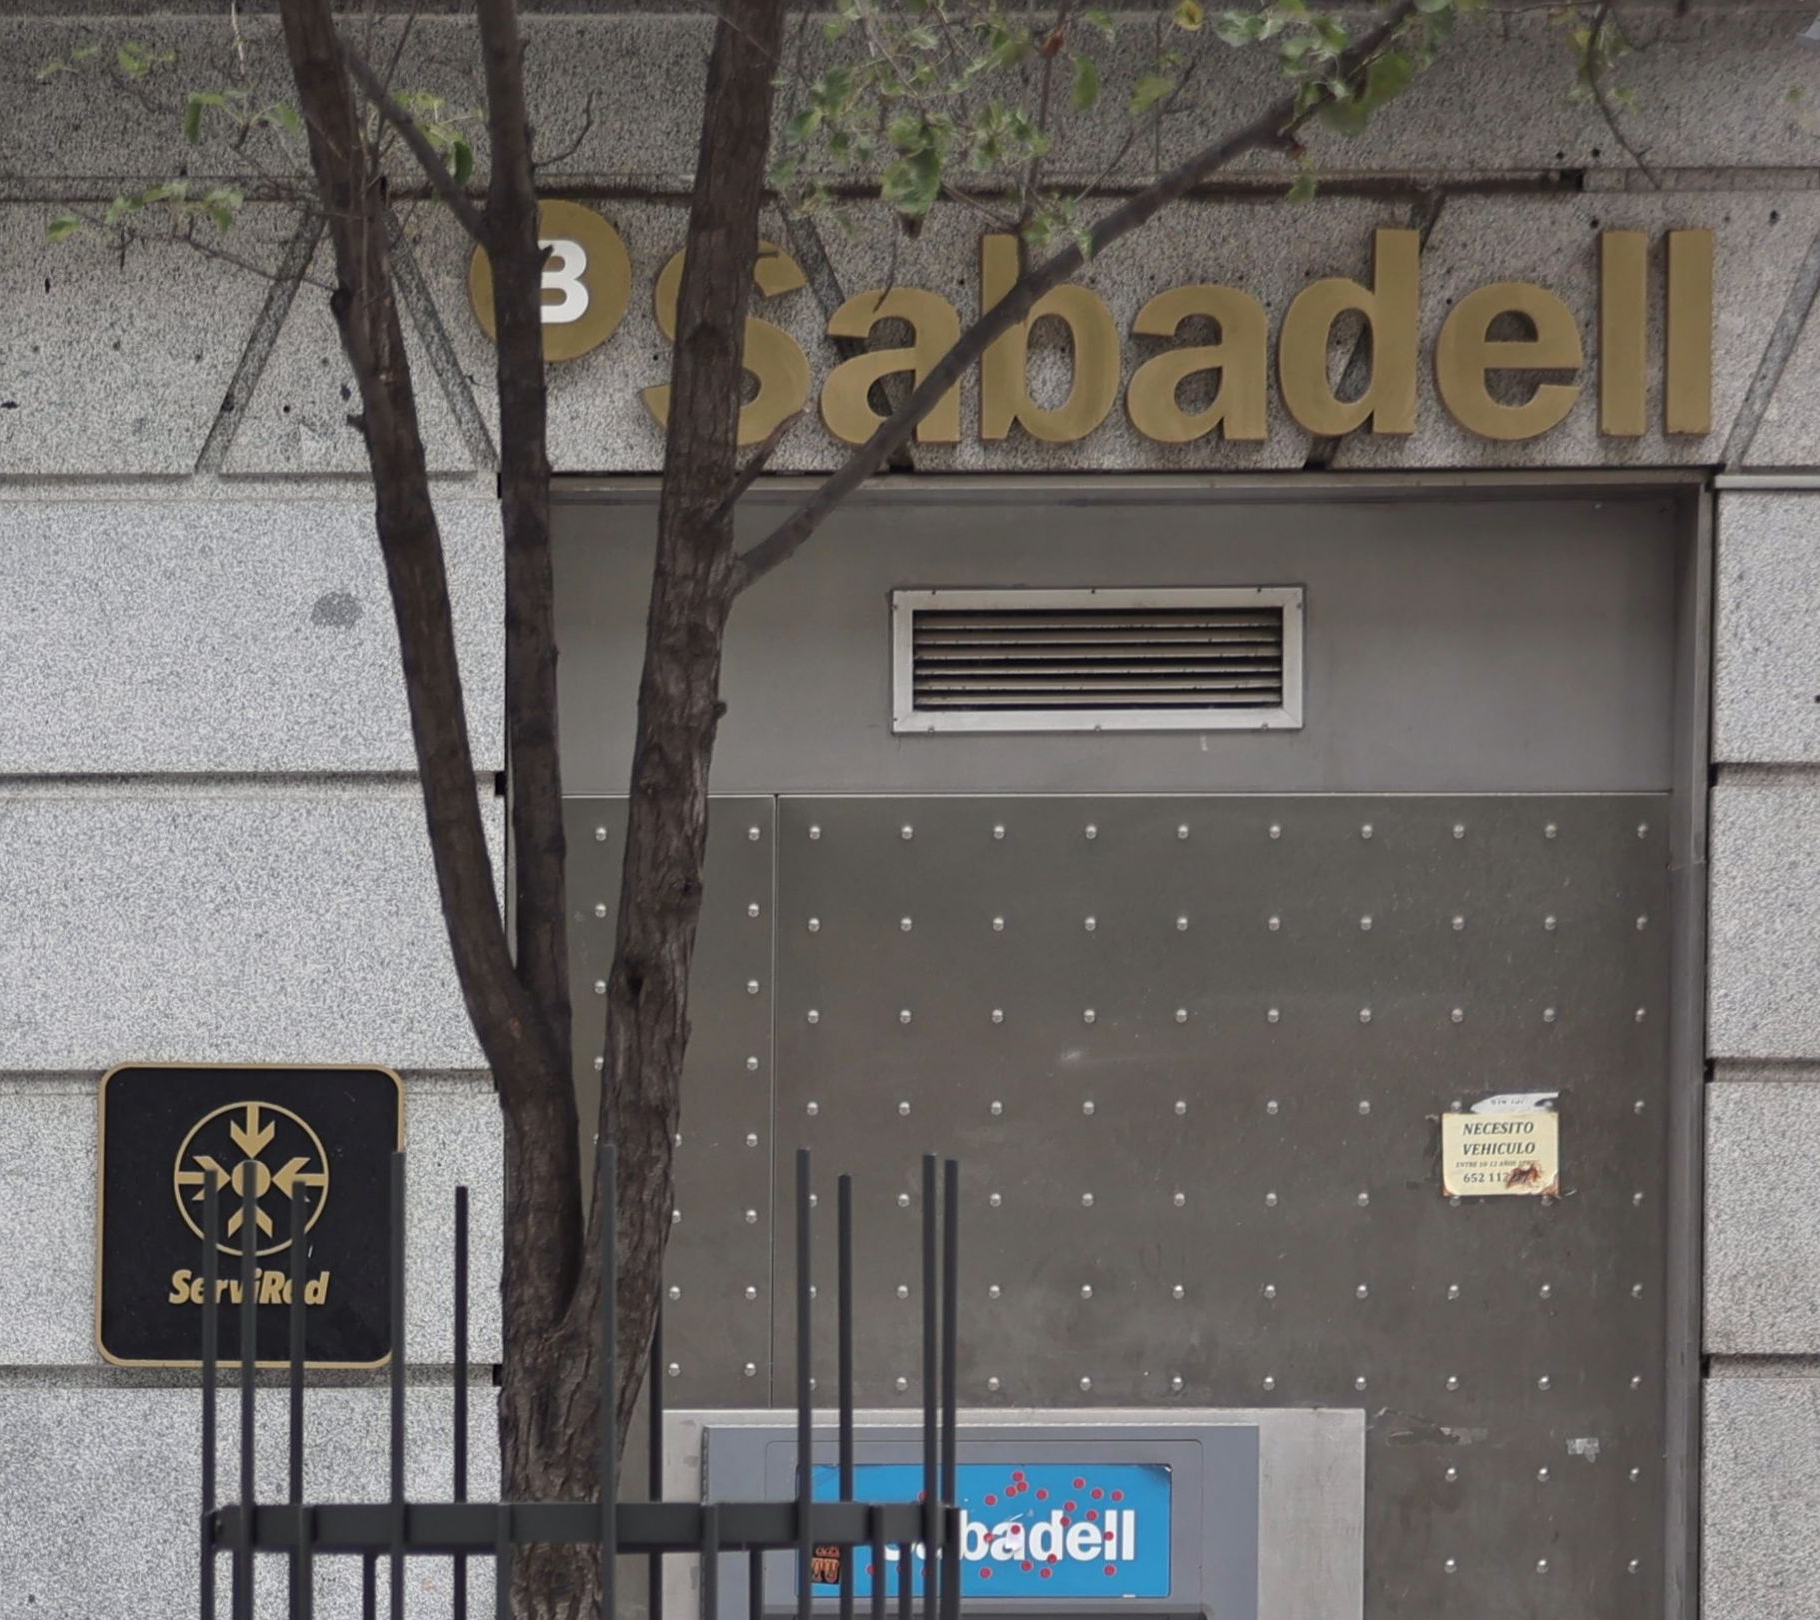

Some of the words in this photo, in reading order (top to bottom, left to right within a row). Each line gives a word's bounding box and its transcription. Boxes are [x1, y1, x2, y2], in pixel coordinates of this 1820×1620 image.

[1463, 1121, 1534, 1136] NECESITO
[1463, 1142, 1536, 1156] VEHICULO
[1463, 1172, 1485, 1183] 652
[168, 1268, 331, 1305] ServiRd
[884, 1509, 1136, 1562] badell
